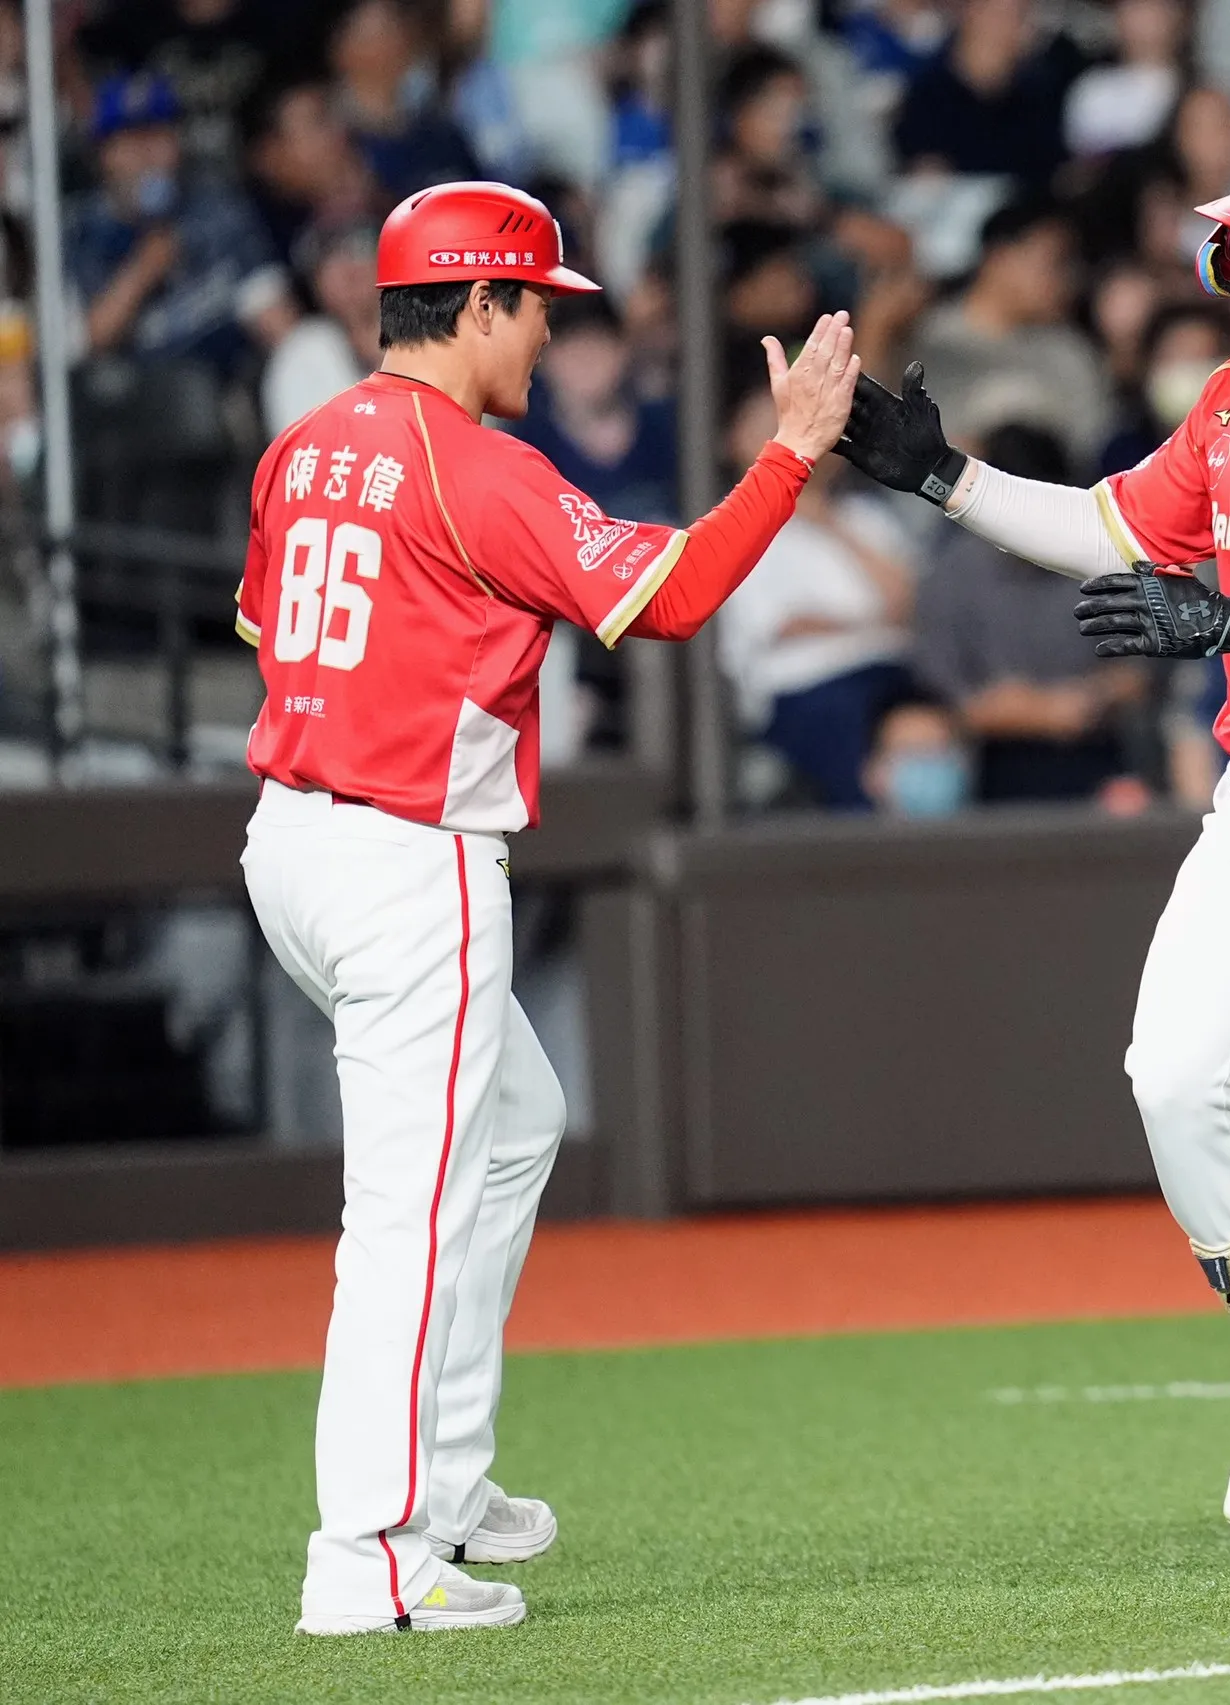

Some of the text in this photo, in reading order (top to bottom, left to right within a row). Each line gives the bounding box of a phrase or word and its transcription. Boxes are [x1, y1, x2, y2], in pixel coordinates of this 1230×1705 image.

[463, 251, 517, 265] 新光人壽
[284, 443, 405, 512] 陳志偉
[274, 516, 382, 672] 86
